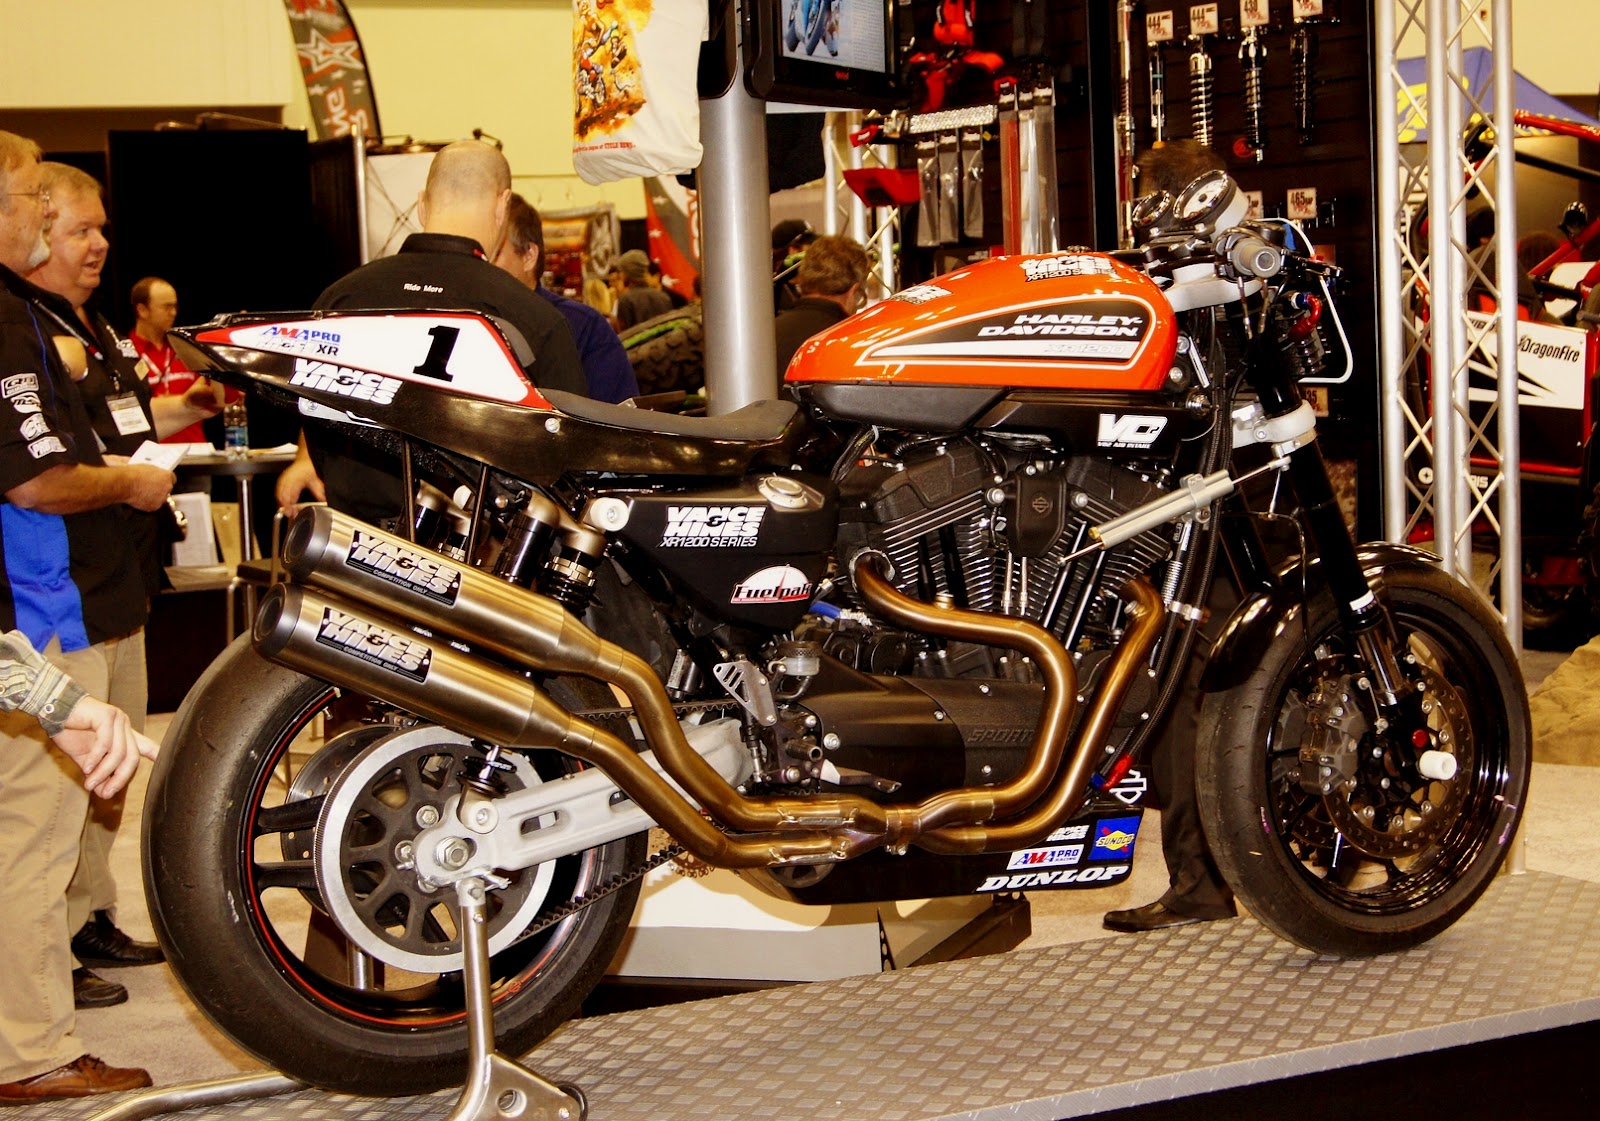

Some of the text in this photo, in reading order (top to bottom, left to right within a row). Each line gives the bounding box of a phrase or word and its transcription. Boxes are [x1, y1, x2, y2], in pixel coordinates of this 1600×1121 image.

[403, 283, 444, 293] Ride More
[261, 326, 309, 341] AMA
[311, 331, 341, 343] PRO
[977, 326, 1138, 337] DAVIDSON
[316, 343, 339, 356] XR
[412, 325, 461, 383] 1
[1520, 337, 1580, 362] DragonFire
[289, 371, 397, 405] HINES
[294, 358, 403, 393] VANCE
[667, 506, 767, 522] VANCE
[664, 521, 760, 537] HINES
[659, 536, 758, 548] XR1200 SERIES
[358, 532, 460, 582] VANCE
[350, 545, 451, 595] HINES
[372, 569, 428, 595] COMPETITION ONLY
[321, 622, 422, 671] HINES
[329, 609, 429, 659] VANCE
[343, 646, 399, 672] COMPETITION ONLY
[1097, 834, 1134, 847] SUNOCO
[1013, 849, 1079, 865] AMA PRO
[976, 865, 1129, 892] DUNLOP
